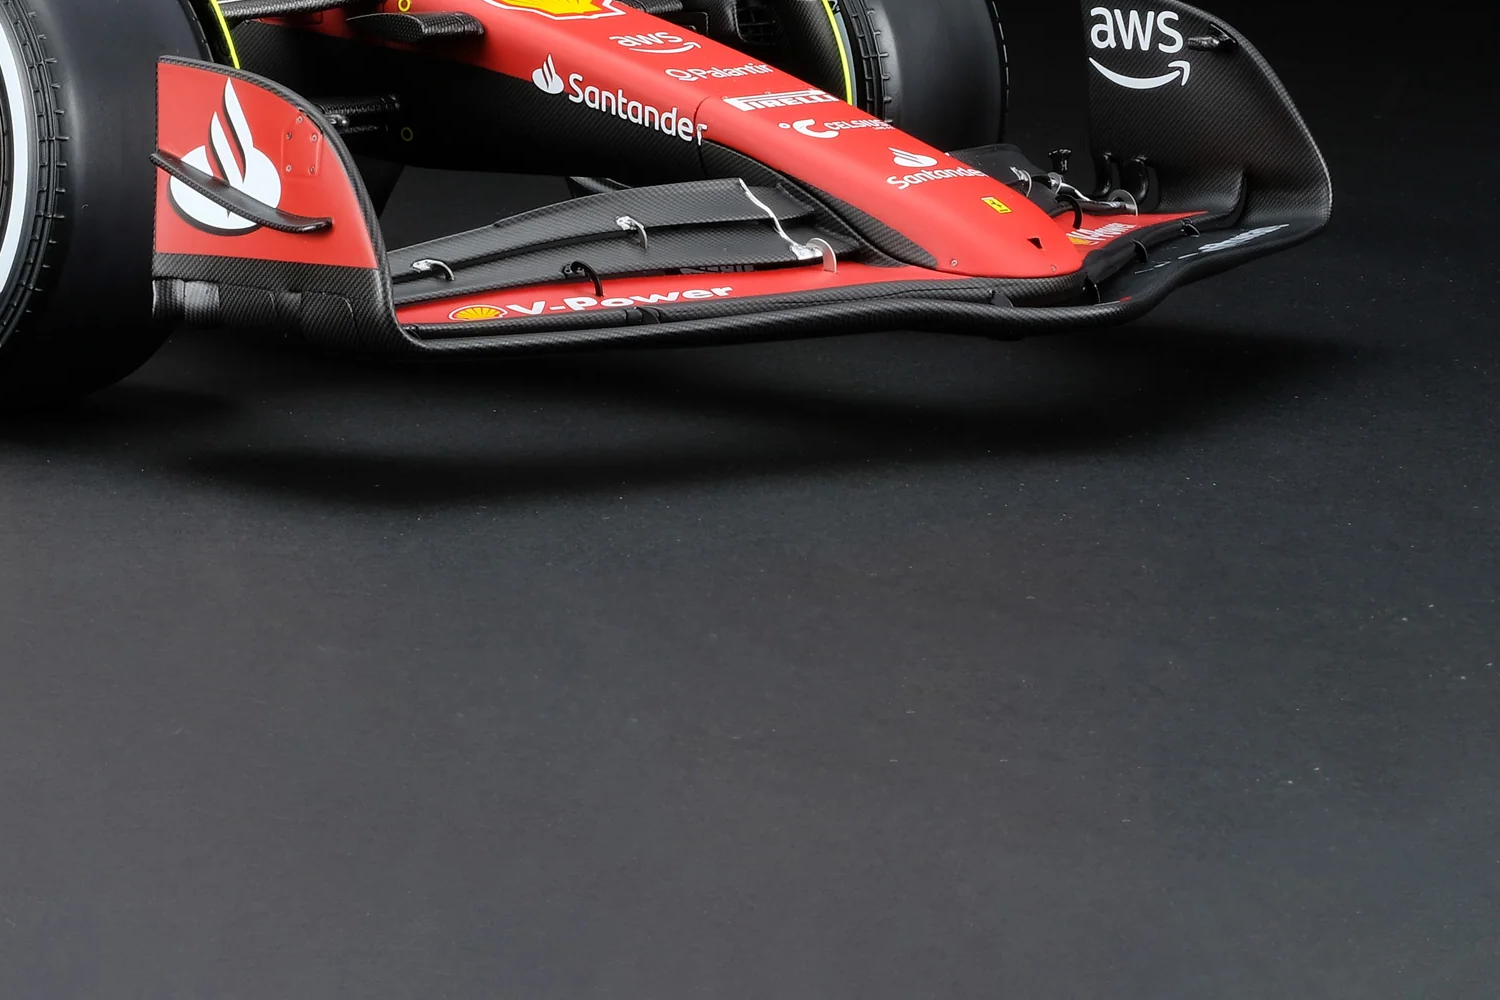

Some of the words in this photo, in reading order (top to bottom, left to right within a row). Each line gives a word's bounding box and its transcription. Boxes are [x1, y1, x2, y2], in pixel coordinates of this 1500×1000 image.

[609, 32, 683, 47] aws
[1090, 6, 1184, 54] aws
[696, 63, 774, 79] Palantir
[568, 73, 707, 146] Santander
[723, 89, 840, 112] PIRELLI
[506, 286, 733, 316] V-Power
